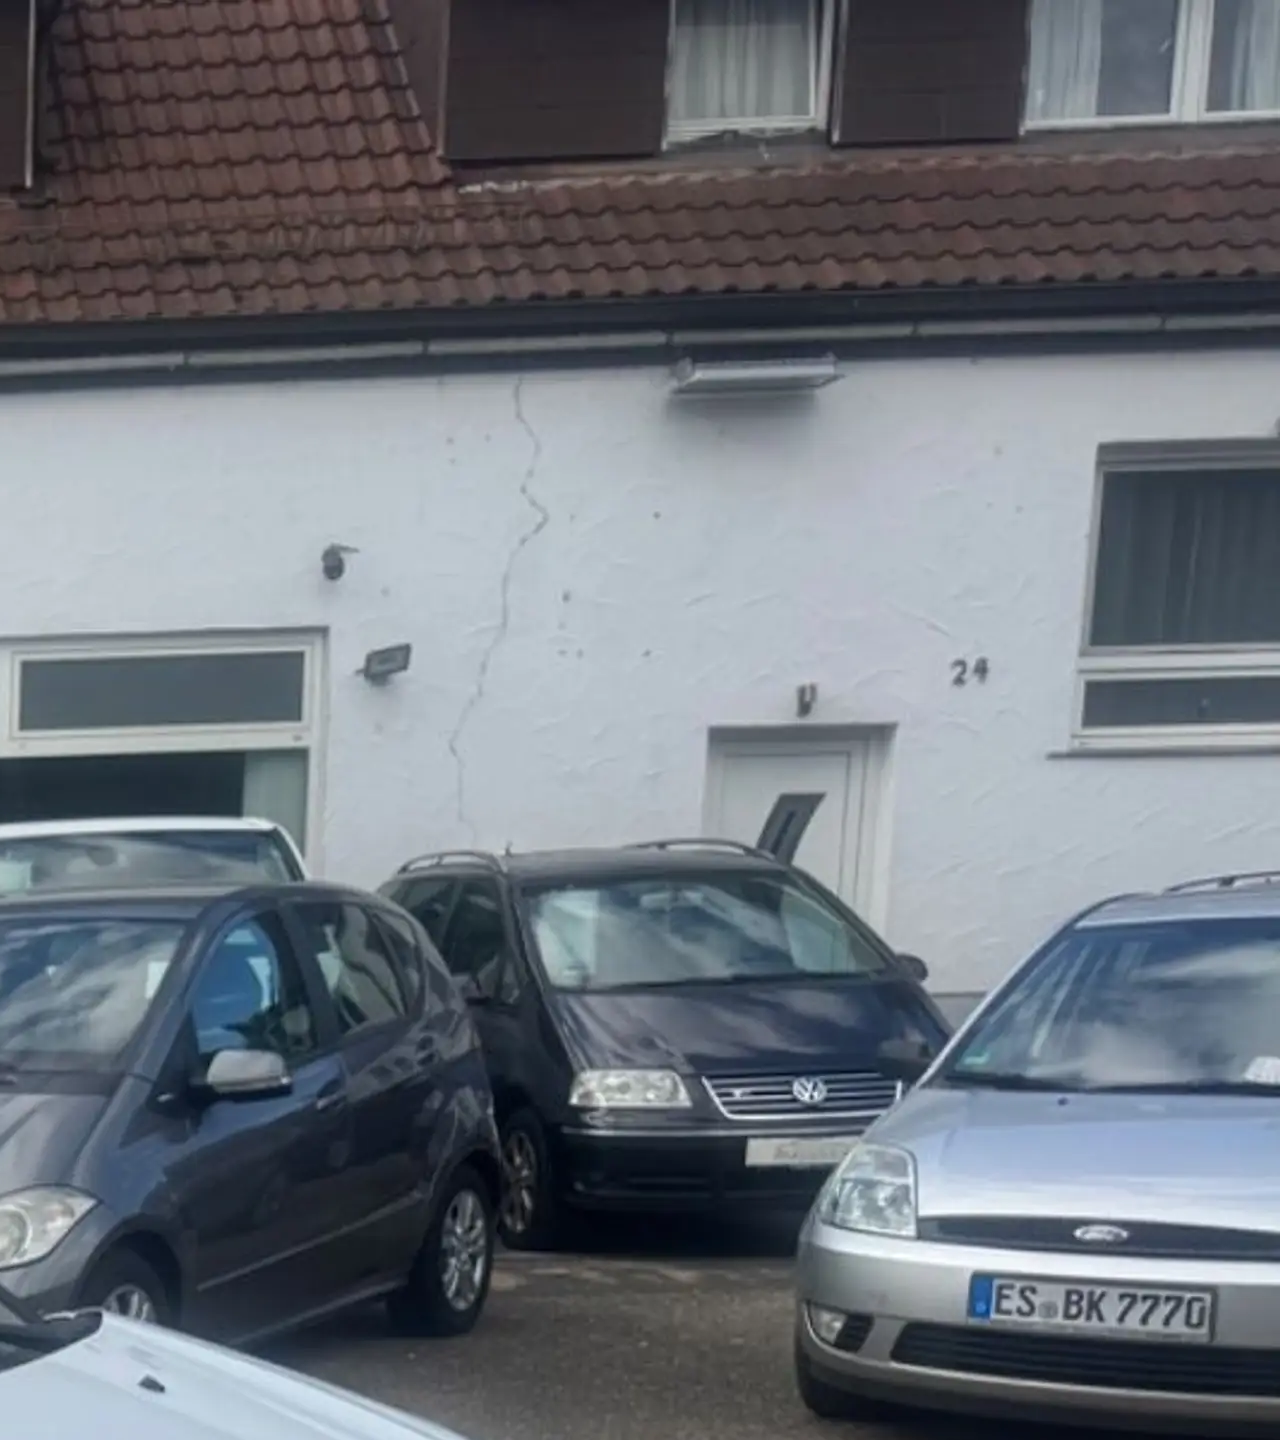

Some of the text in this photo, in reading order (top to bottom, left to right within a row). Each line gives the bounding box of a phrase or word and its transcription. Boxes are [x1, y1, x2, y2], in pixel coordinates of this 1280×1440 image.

[994, 1283, 1207, 1329] ES BK 7770
